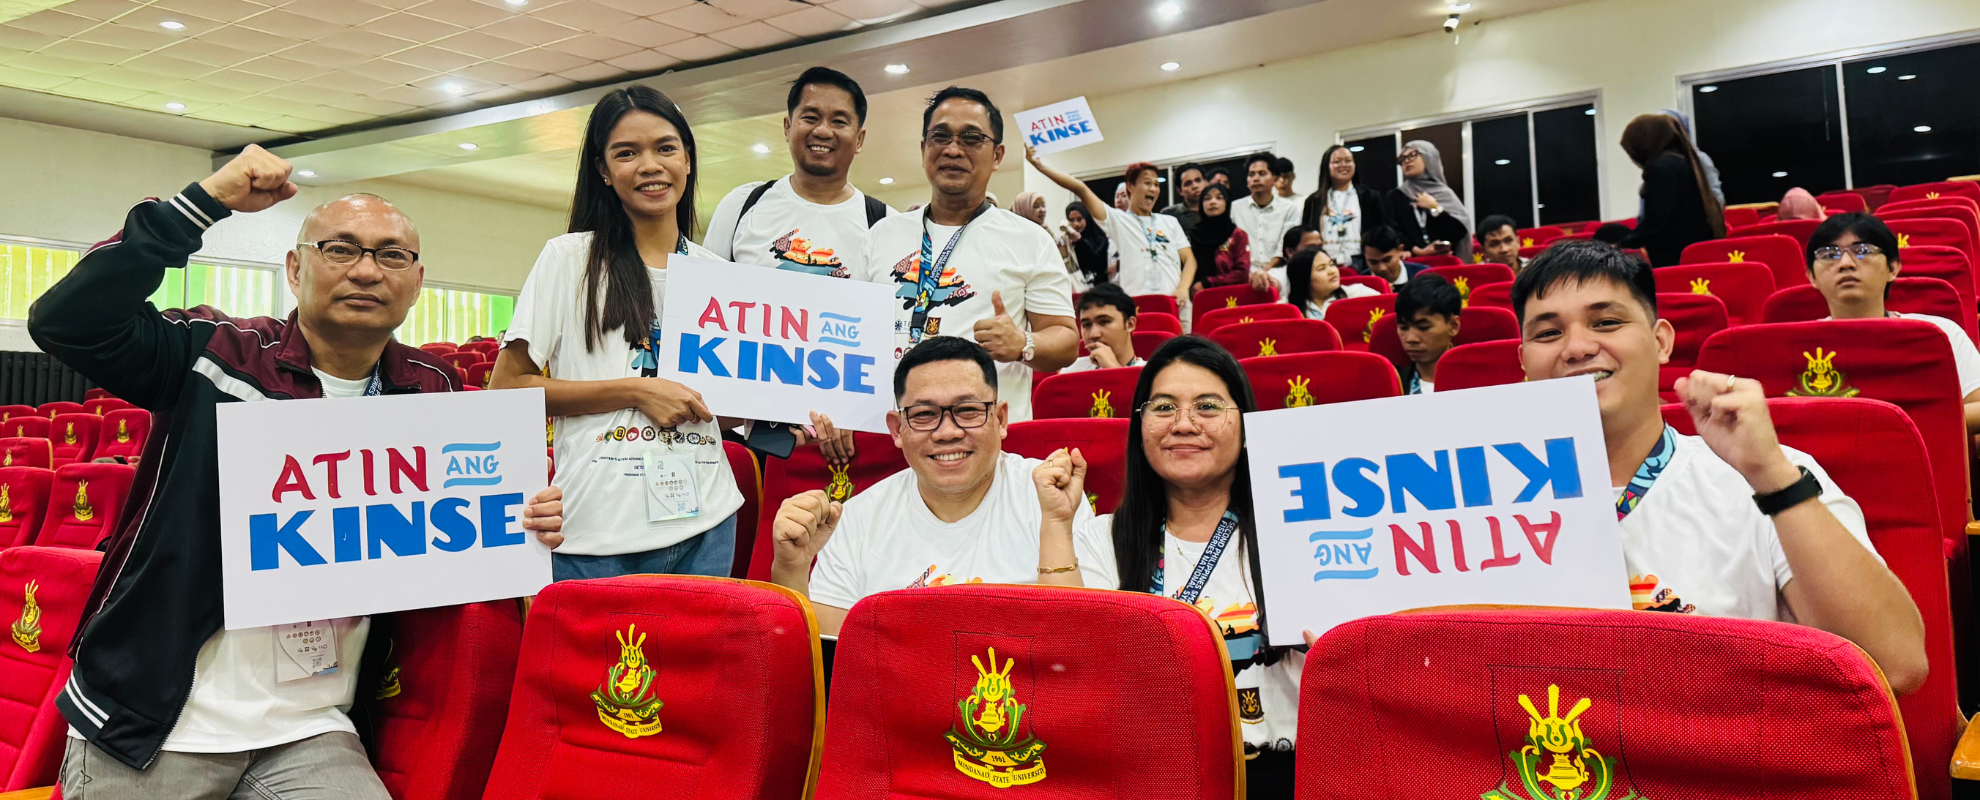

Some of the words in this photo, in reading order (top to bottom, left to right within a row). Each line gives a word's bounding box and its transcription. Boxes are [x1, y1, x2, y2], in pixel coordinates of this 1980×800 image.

[1029, 120, 1093, 146] KINSE
[1031, 114, 1066, 131] ATIN
[698, 296, 809, 342] ATIN
[821, 320, 860, 339] ANG
[678, 332, 875, 394] KINSE
[272, 445, 430, 503] ATIN
[446, 454, 500, 476] ANG
[1278, 436, 1584, 523] KINSE
[249, 492, 526, 571] KINSE
[1205, 520, 1227, 555] FISHERIES
[1217, 521, 1236, 549] SECOND
[1388, 510, 1562, 576] ATIN
[1194, 549, 1222, 590] PHILIPPINES
[1313, 542, 1372, 566] ANG
[1186, 555, 1211, 589] NATIONAL
[957, 760, 990, 779] MINDANAO
[992, 775, 1010, 784] STATE
[991, 755, 1006, 763] 1961
